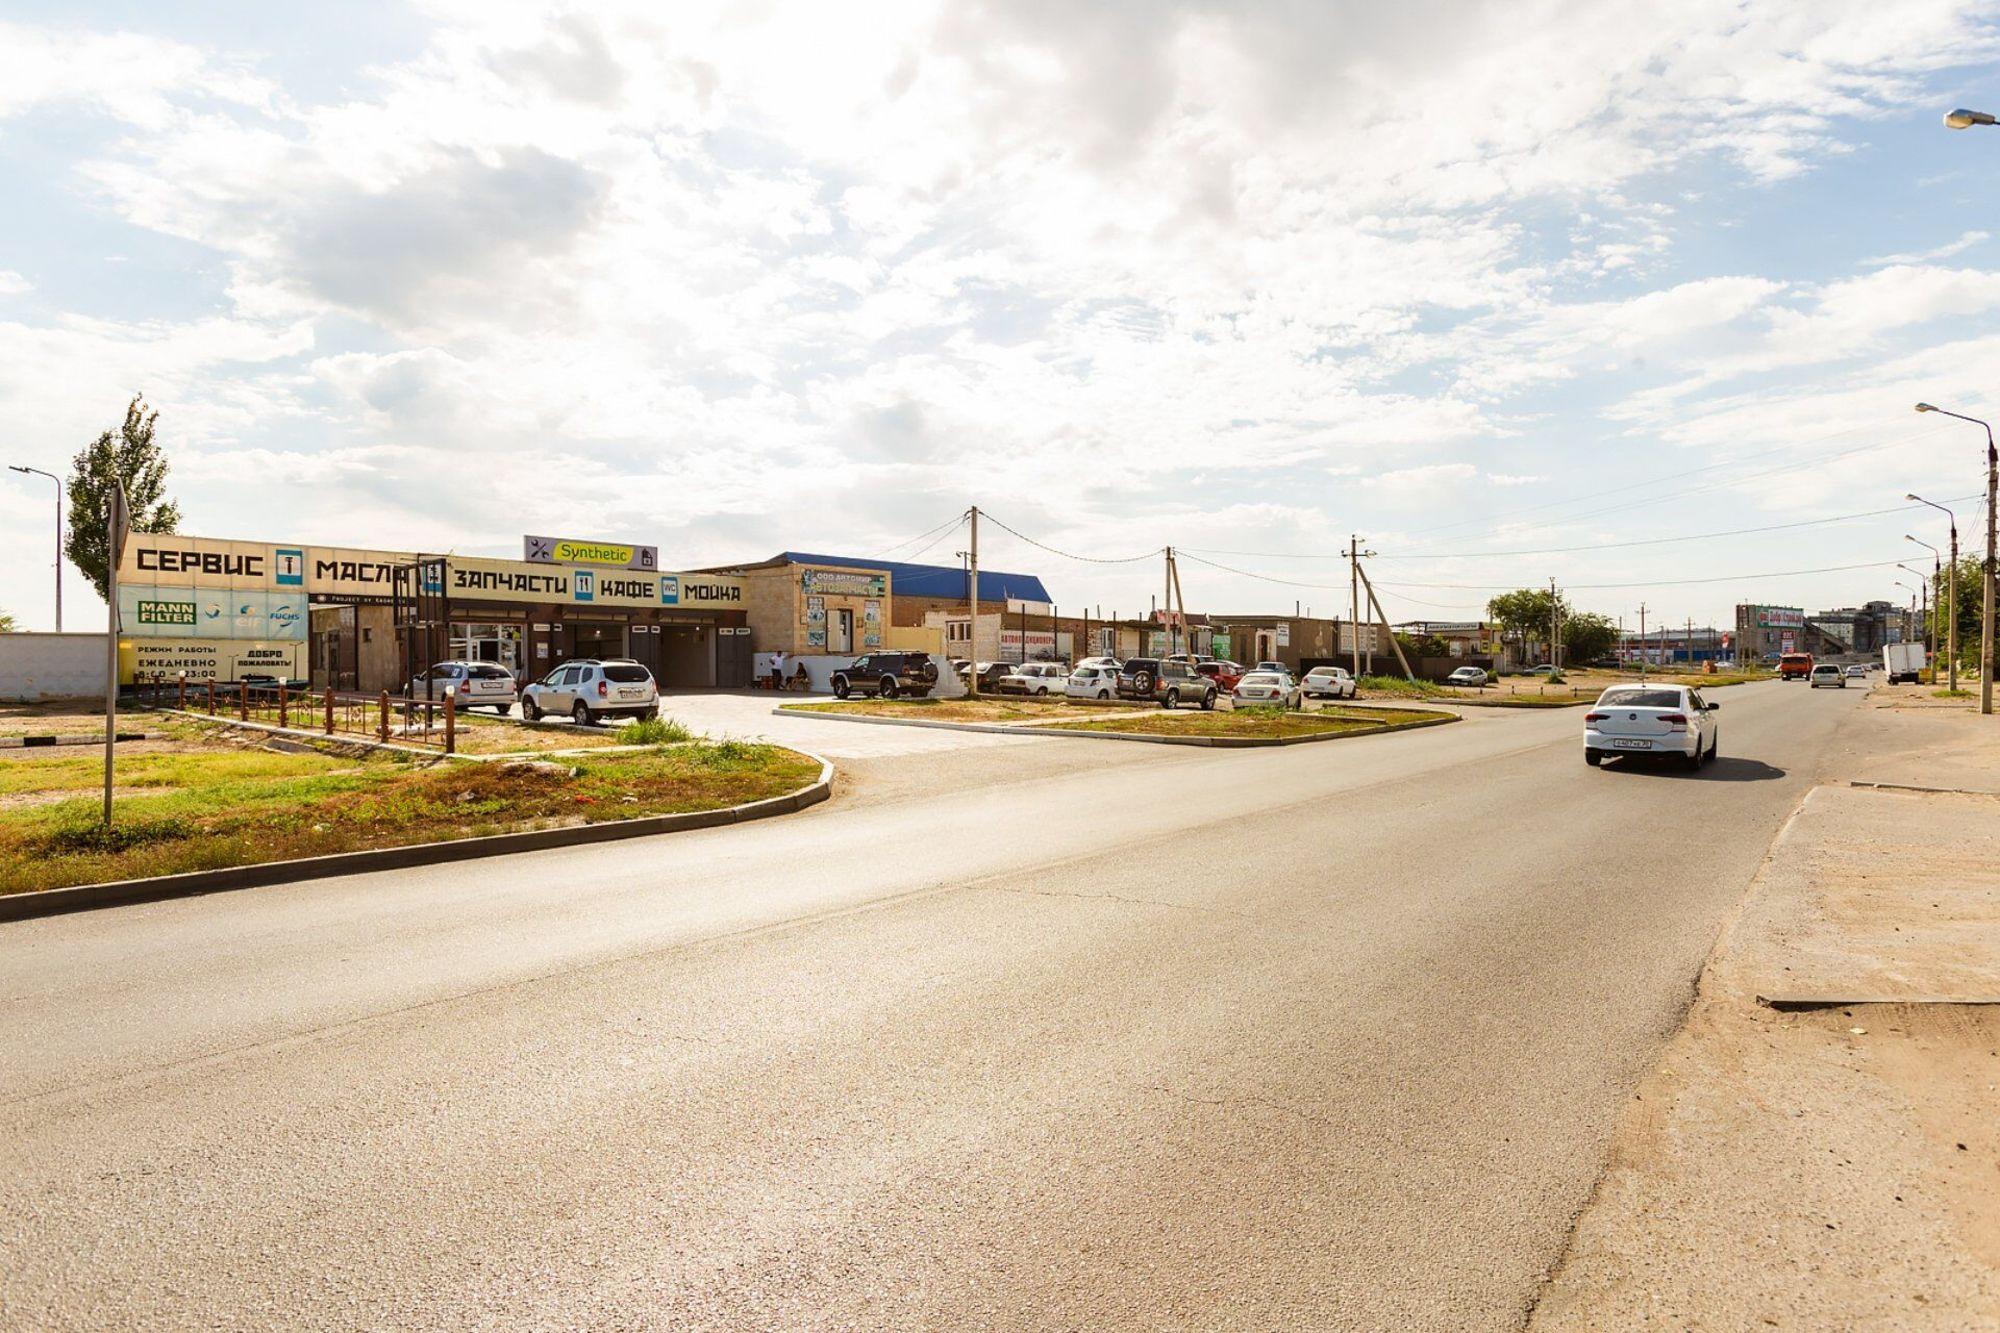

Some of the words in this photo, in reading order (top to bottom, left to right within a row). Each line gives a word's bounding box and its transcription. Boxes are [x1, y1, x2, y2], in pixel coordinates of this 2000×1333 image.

[561, 544, 627, 562] Synthetic
[137, 549, 263, 576] СЕРВИС
[454, 570, 567, 594] ЗАПЧАСТИ
[601, 580, 654, 598] КАФЕ
[685, 584, 741, 601] МОЙКА
[141, 603, 194, 613] MANN
[141, 613, 194, 622] FILTER
[270, 612, 300, 620] FUCHS
[138, 659, 217, 667] ЕЖЕДНЕВНО
